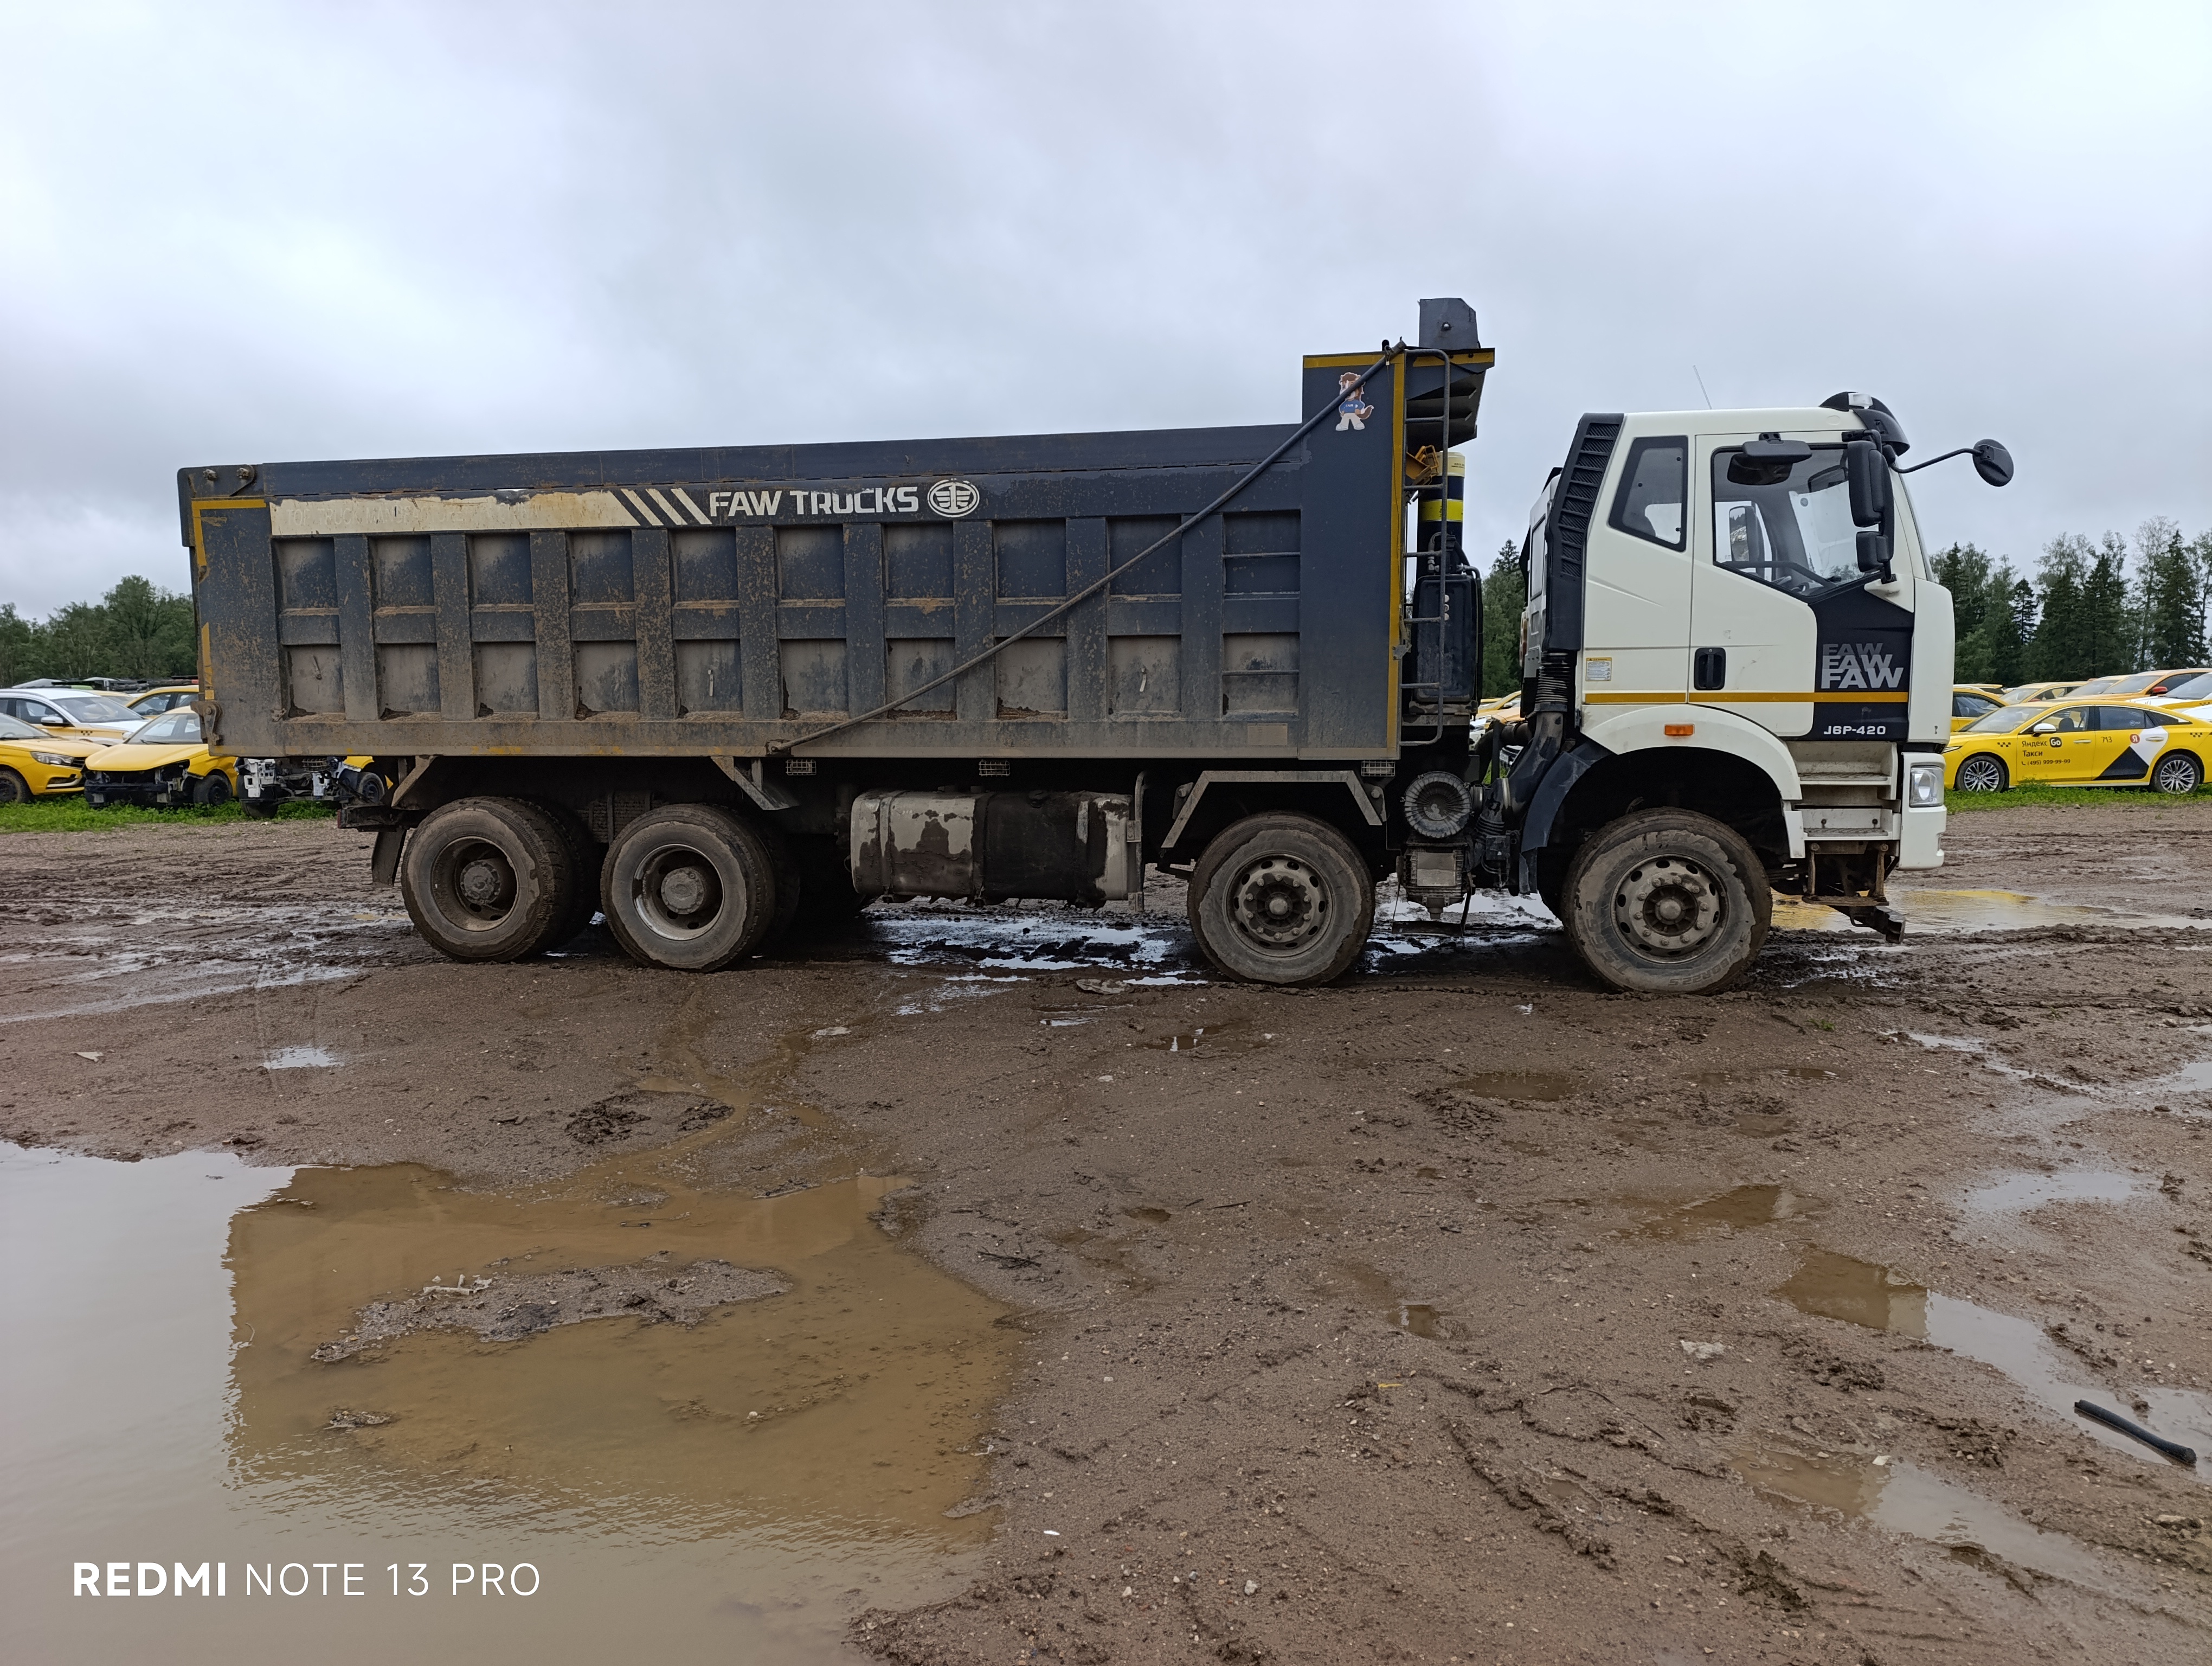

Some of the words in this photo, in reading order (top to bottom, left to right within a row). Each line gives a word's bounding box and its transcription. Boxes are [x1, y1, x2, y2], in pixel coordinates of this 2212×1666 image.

[710, 490, 782, 517] FAW
[789, 486, 918, 515] TRUCKS
[1822, 654, 1893, 671] FAW
[1821, 667, 1904, 689] FAW
[1823, 726, 1886, 735] J6P-420
[2050, 738, 2061, 746] Go
[2131, 735, 2139, 743] Я
